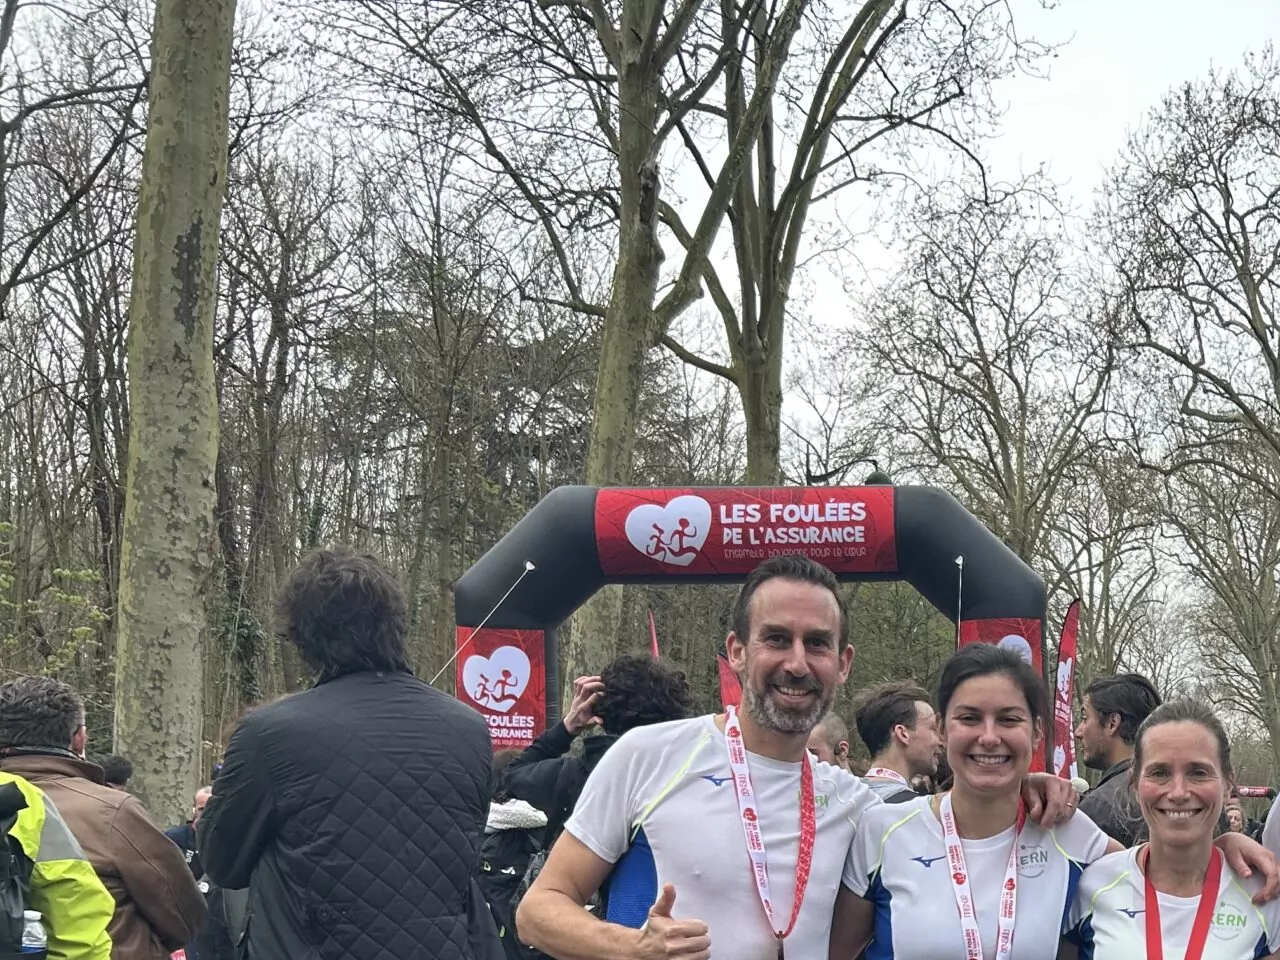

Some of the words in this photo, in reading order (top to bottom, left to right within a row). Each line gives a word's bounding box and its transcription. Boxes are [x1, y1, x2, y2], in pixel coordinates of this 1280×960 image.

[720, 503, 762, 524] LES
[770, 498, 867, 523] FOULÉES
[723, 527, 743, 545] DE
[750, 525, 865, 545] L'ASSURANCE
[1018, 850, 1048, 866] ERN
[1212, 913, 1247, 928] ERN
